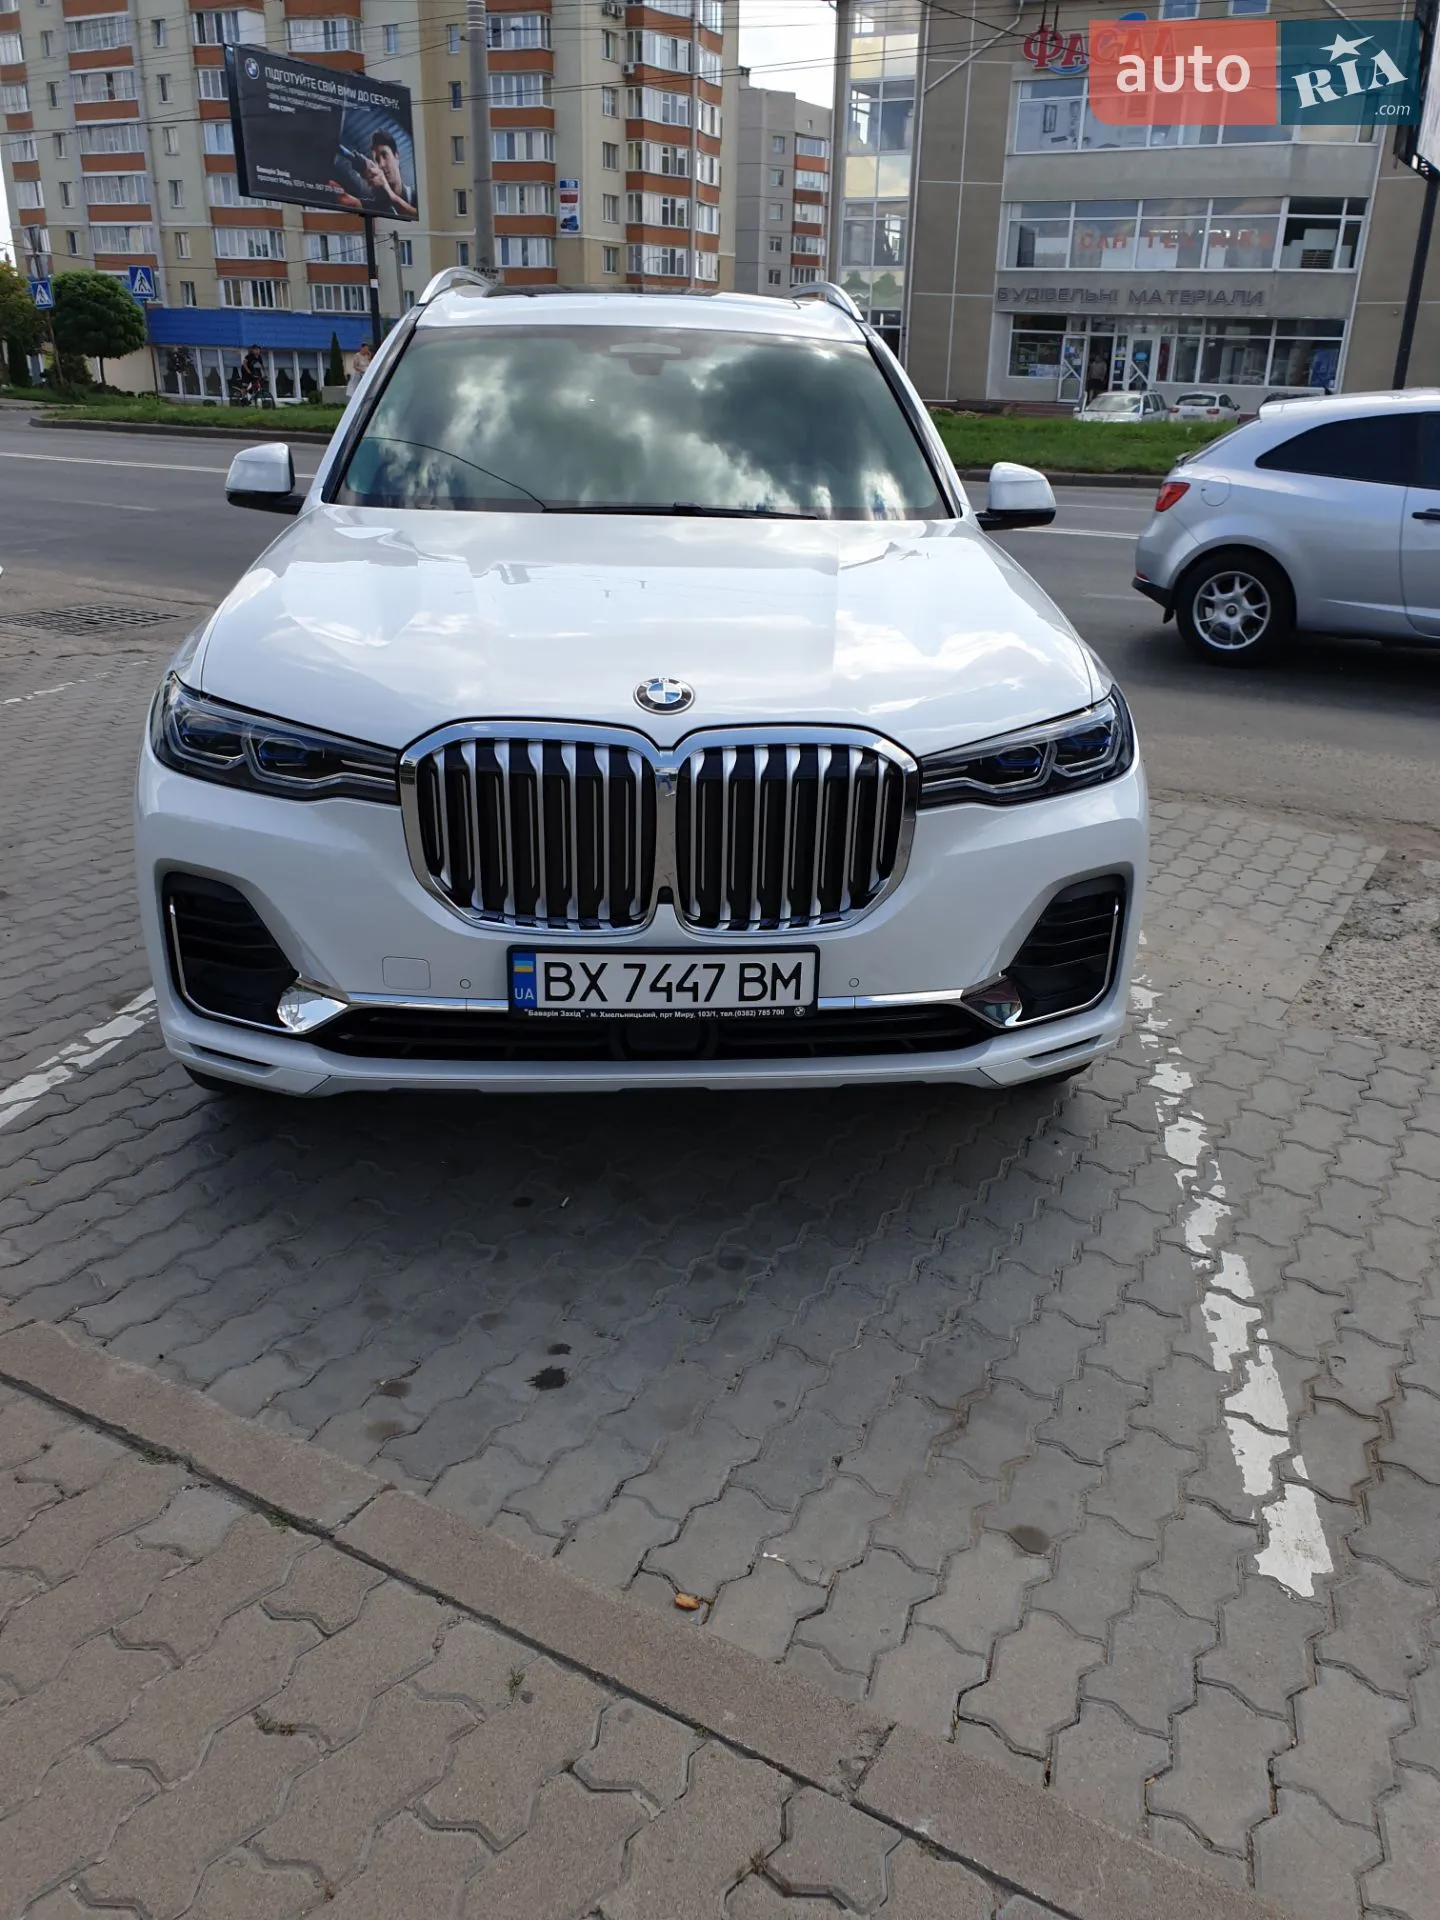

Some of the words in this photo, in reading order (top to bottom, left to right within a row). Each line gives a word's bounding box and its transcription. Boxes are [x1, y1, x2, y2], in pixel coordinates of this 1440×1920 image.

[265, 66, 317, 90] ПІДГОТУЙТЕ
[317, 79, 337, 94] СВІЙ
[337, 84, 357, 99] BMW
[357, 89, 369, 103] ДО
[997, 286, 1121, 305] БУДІВЕЛЬНІ
[1128, 288, 1266, 307] МАТЕРІАЛИ
[544, 961, 609, 1002] BX
[622, 962, 727, 1003] 7447
[738, 961, 803, 1002] BM
[514, 987, 535, 1001] UA
[758, 1009, 771, 1017] 785
[772, 1008, 785, 1016] 700
